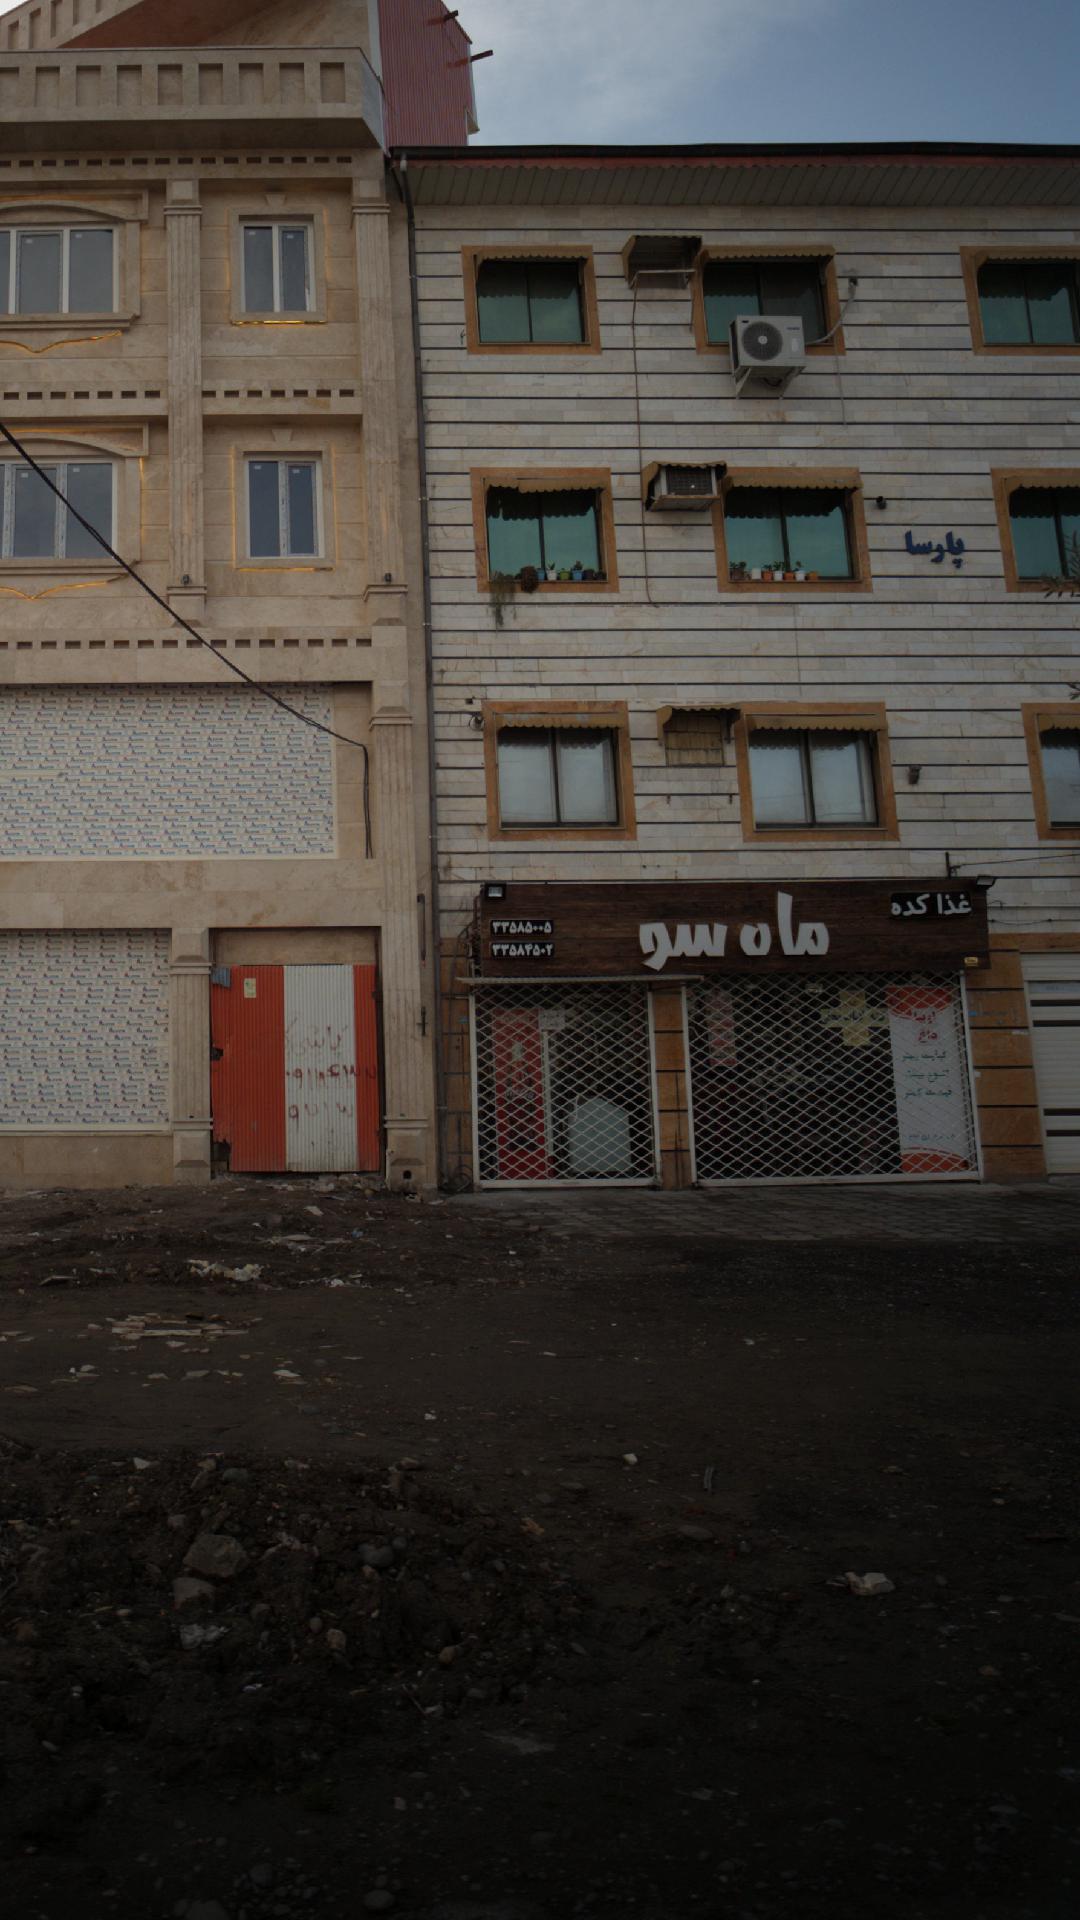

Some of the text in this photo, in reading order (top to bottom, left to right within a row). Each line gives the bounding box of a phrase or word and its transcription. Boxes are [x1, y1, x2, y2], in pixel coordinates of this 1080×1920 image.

[890, 892, 972, 916] غذا کده
[639, 891, 830, 972] ماه سو
